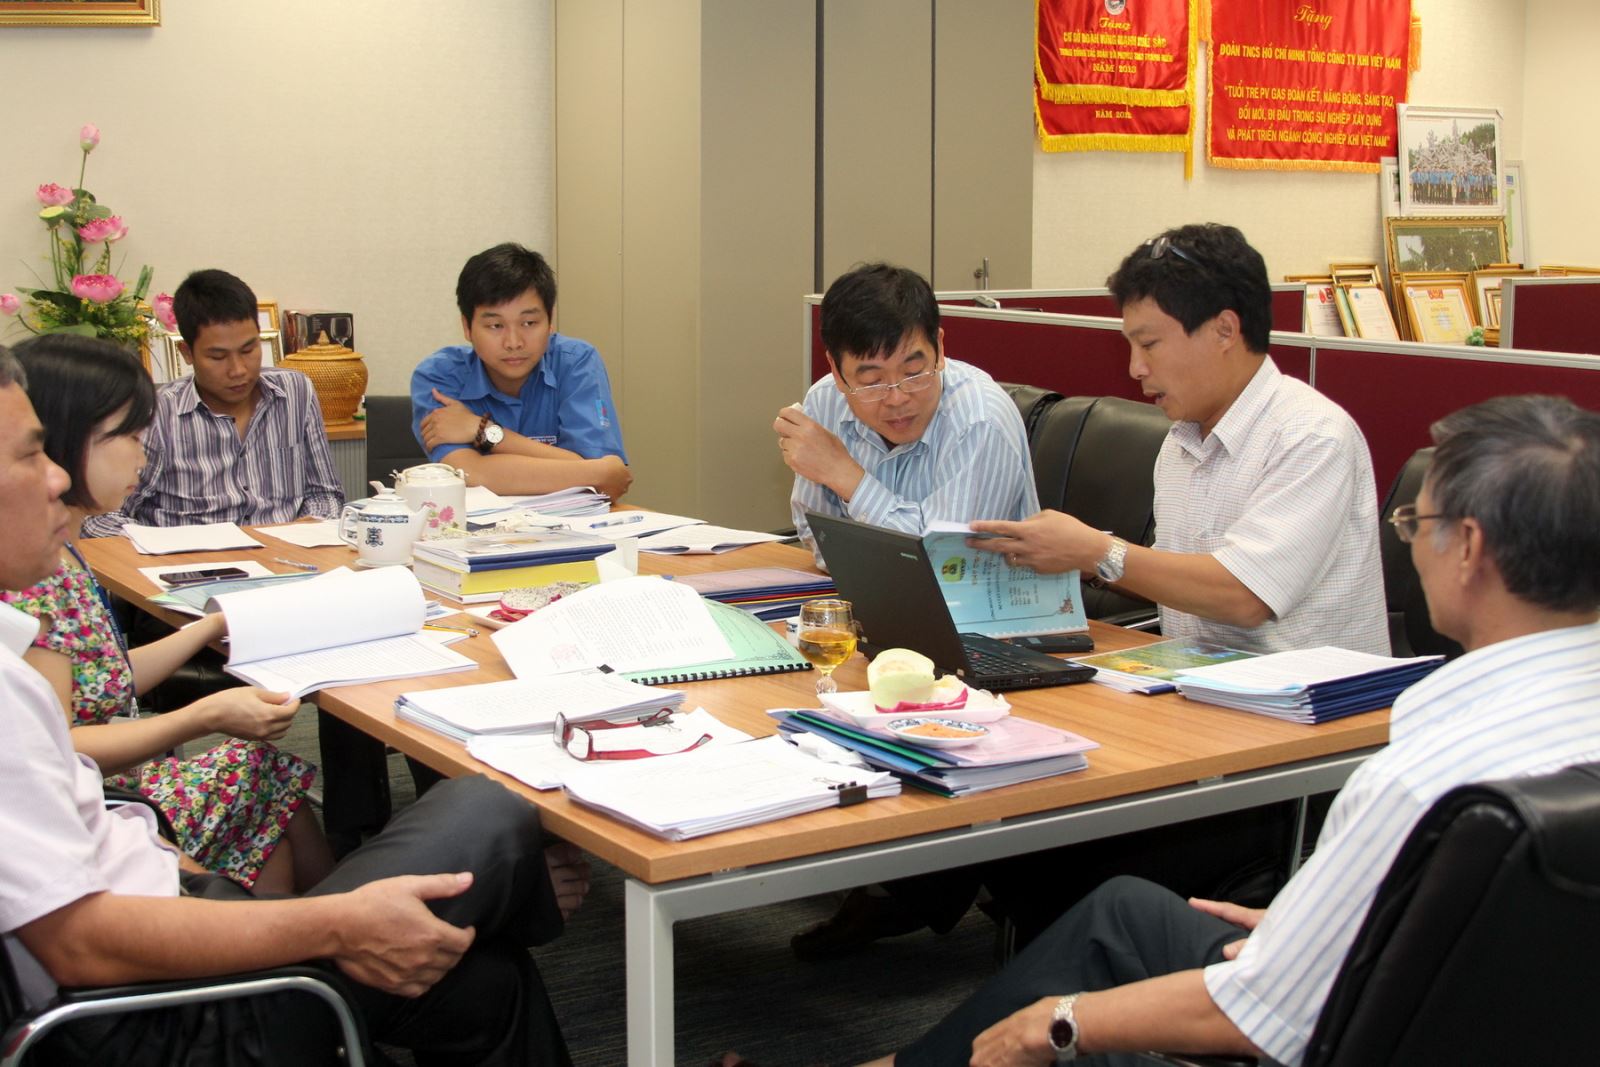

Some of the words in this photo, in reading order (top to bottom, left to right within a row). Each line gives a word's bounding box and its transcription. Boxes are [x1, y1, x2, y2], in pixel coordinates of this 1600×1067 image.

[1293, 4, 1333, 30] Tặng
[1219, 40, 1240, 56] ĐOÀN
[1242, 45, 1260, 58] TNCS
[1274, 44, 1288, 60] CHÍ
[1288, 49, 1305, 61] MINH
[1307, 43, 1326, 63] TỔNG
[1327, 49, 1345, 65] CÔNG
[1346, 53, 1356, 65] TY
[1357, 51, 1370, 67] KHÍ
[1370, 53, 1384, 70] VIỆT
[1385, 57, 1402, 70] NAM
[1260, 87, 1270, 99] PV
[1271, 87, 1286, 100] GAS
[1287, 85, 1306, 101] ĐOÀN
[1323, 88, 1341, 103] NĂNG
[1238, 101, 1250, 119] ĐỔI
[1267, 108, 1276, 120] ĐI
[1292, 110, 1315, 122] TRONG
[1327, 110, 1351, 127] NGHIỆP
[1352, 111, 1365, 125] XÂY
[1237, 126, 1256, 141] PHÁT
[1256, 123, 1277, 141] TRIỂN
[1278, 127, 1302, 143] NGÀNH
[1302, 129, 1322, 143] CÔNG
[1323, 130, 1347, 148] NGHIỆP
[1360, 132, 1373, 149] VIỆT
